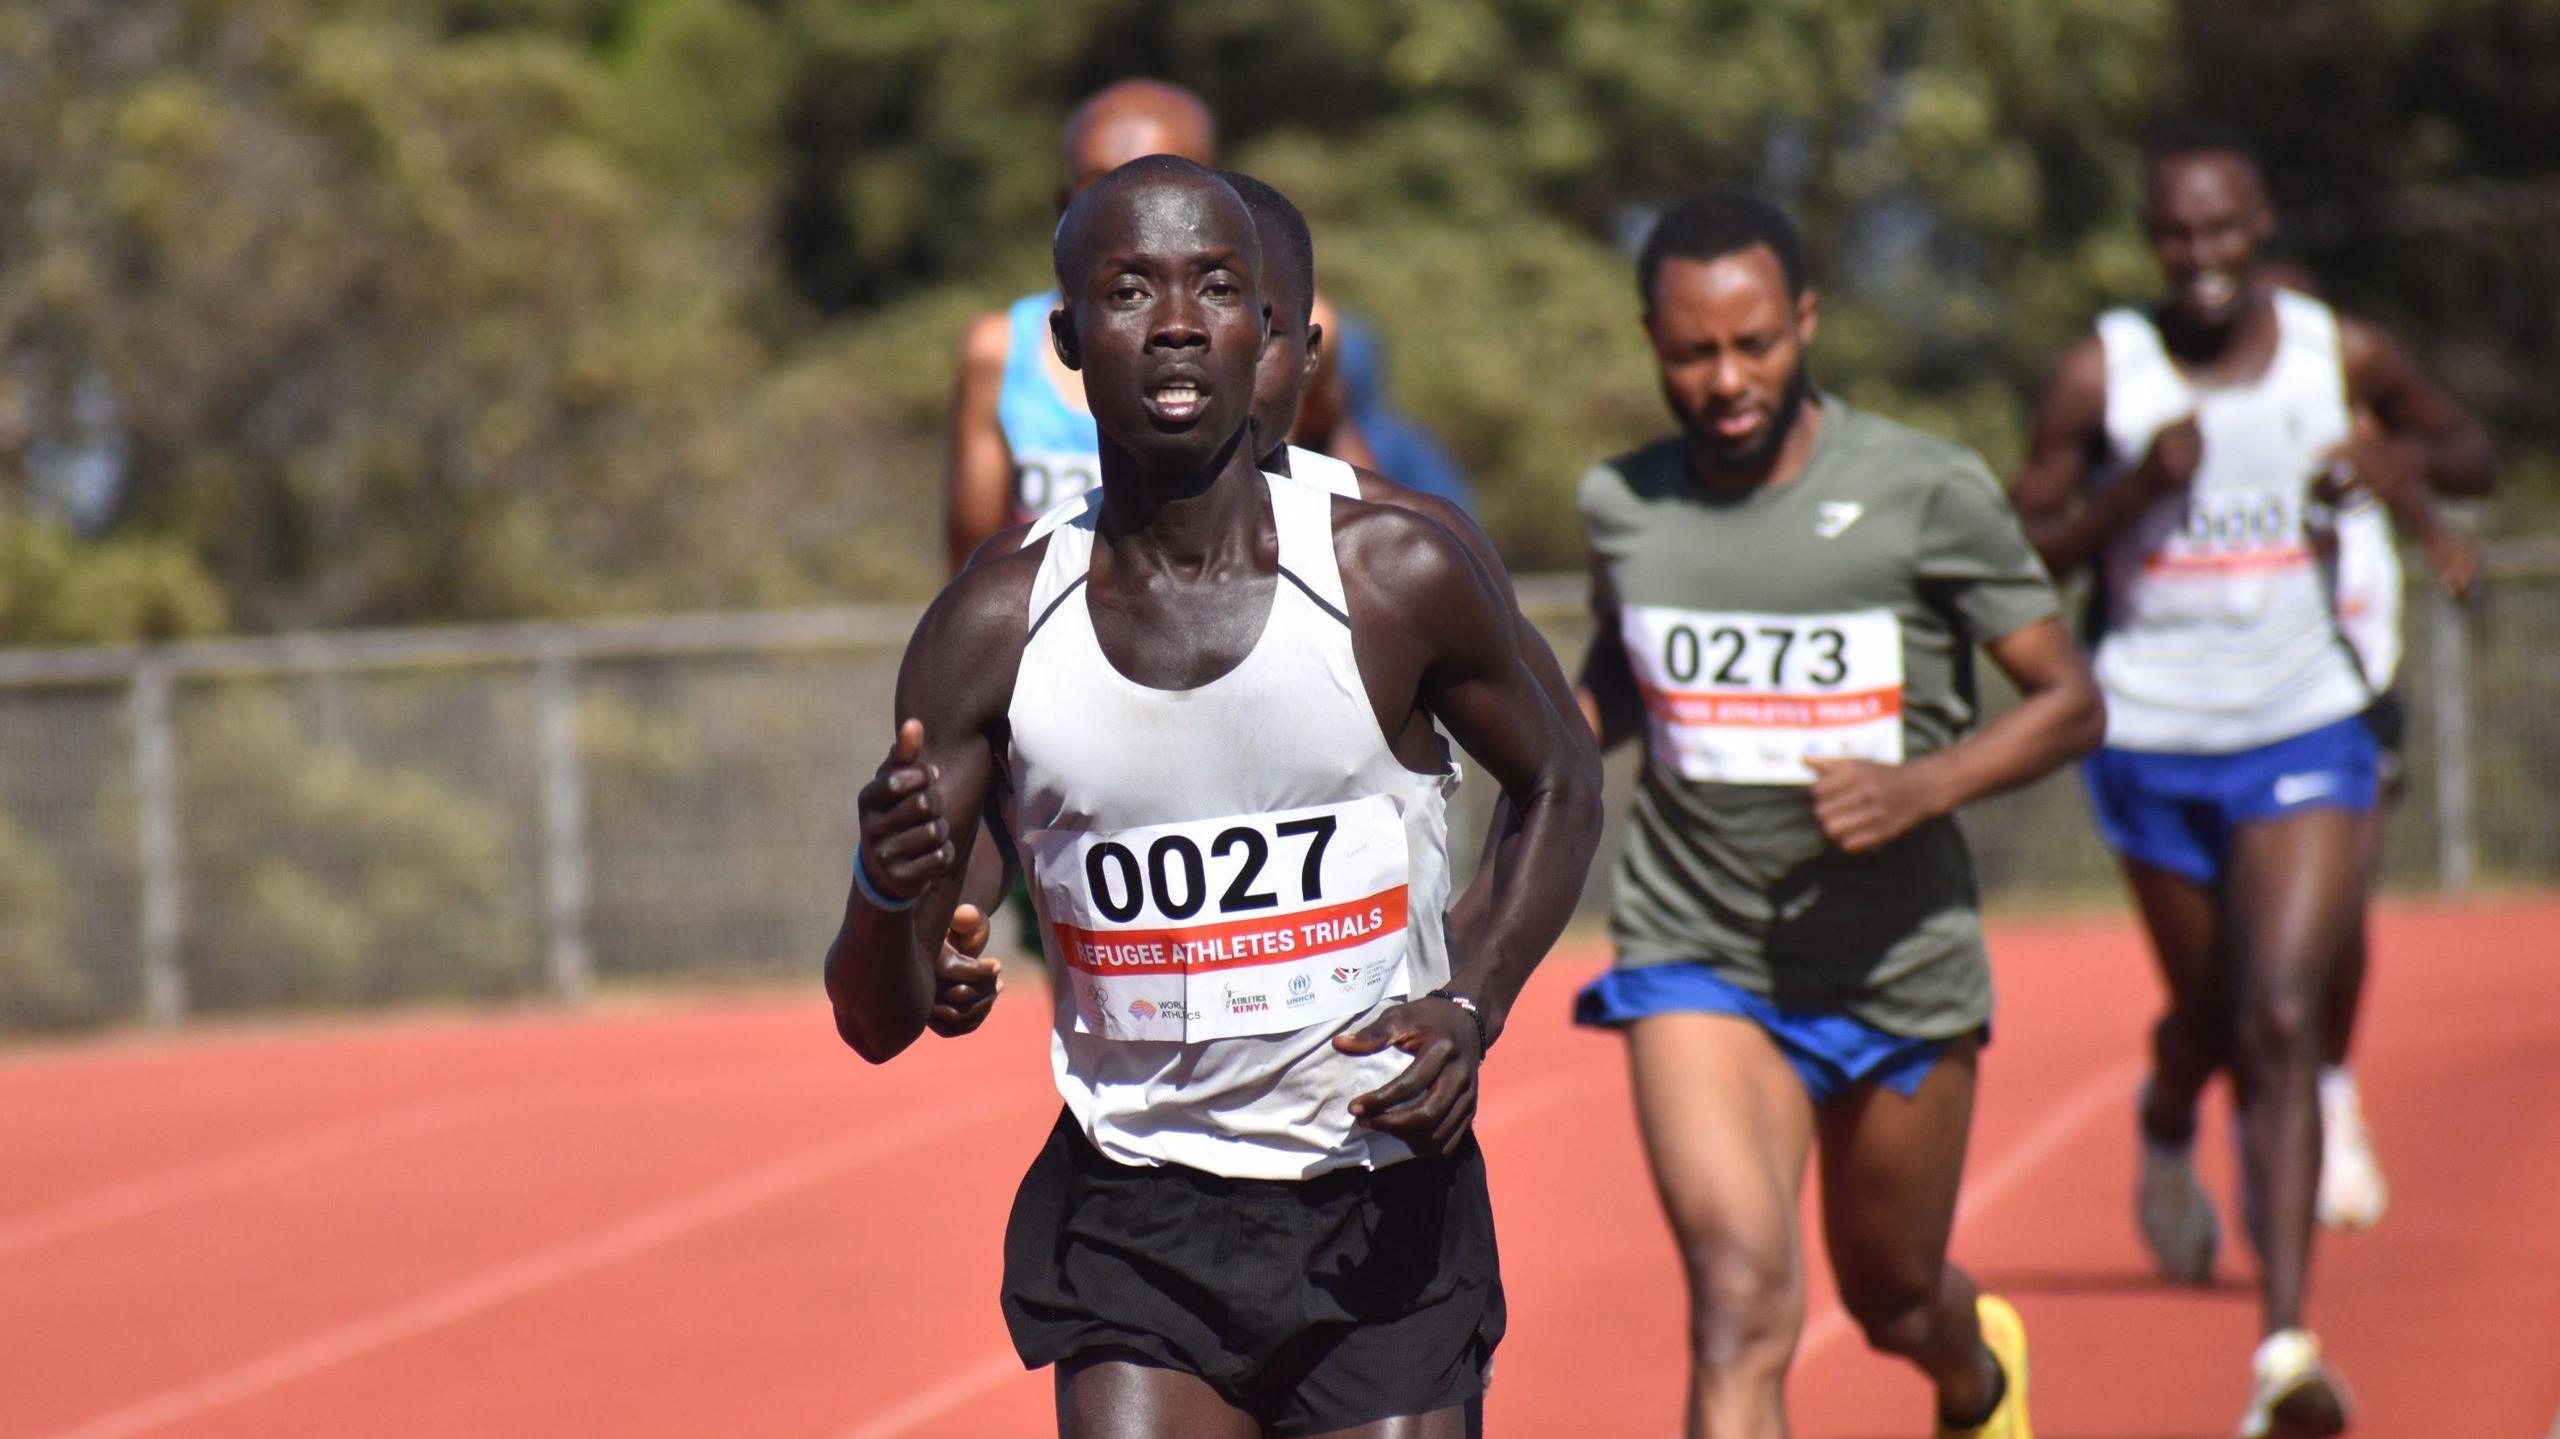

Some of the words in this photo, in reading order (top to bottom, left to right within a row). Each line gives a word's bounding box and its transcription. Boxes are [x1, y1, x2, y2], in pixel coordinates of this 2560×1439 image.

[1665, 624, 1848, 686] 0273
[1085, 814, 1338, 924] 0027
[1077, 941, 1167, 966] REFUGEE
[1172, 929, 1295, 964] ATHLETES
[1301, 908, 1383, 948] TRIALS
[1159, 1001, 1187, 1009] WORL
[1233, 1003, 1269, 1014] KENYA
[1286, 993, 1316, 1005] UNHCR
